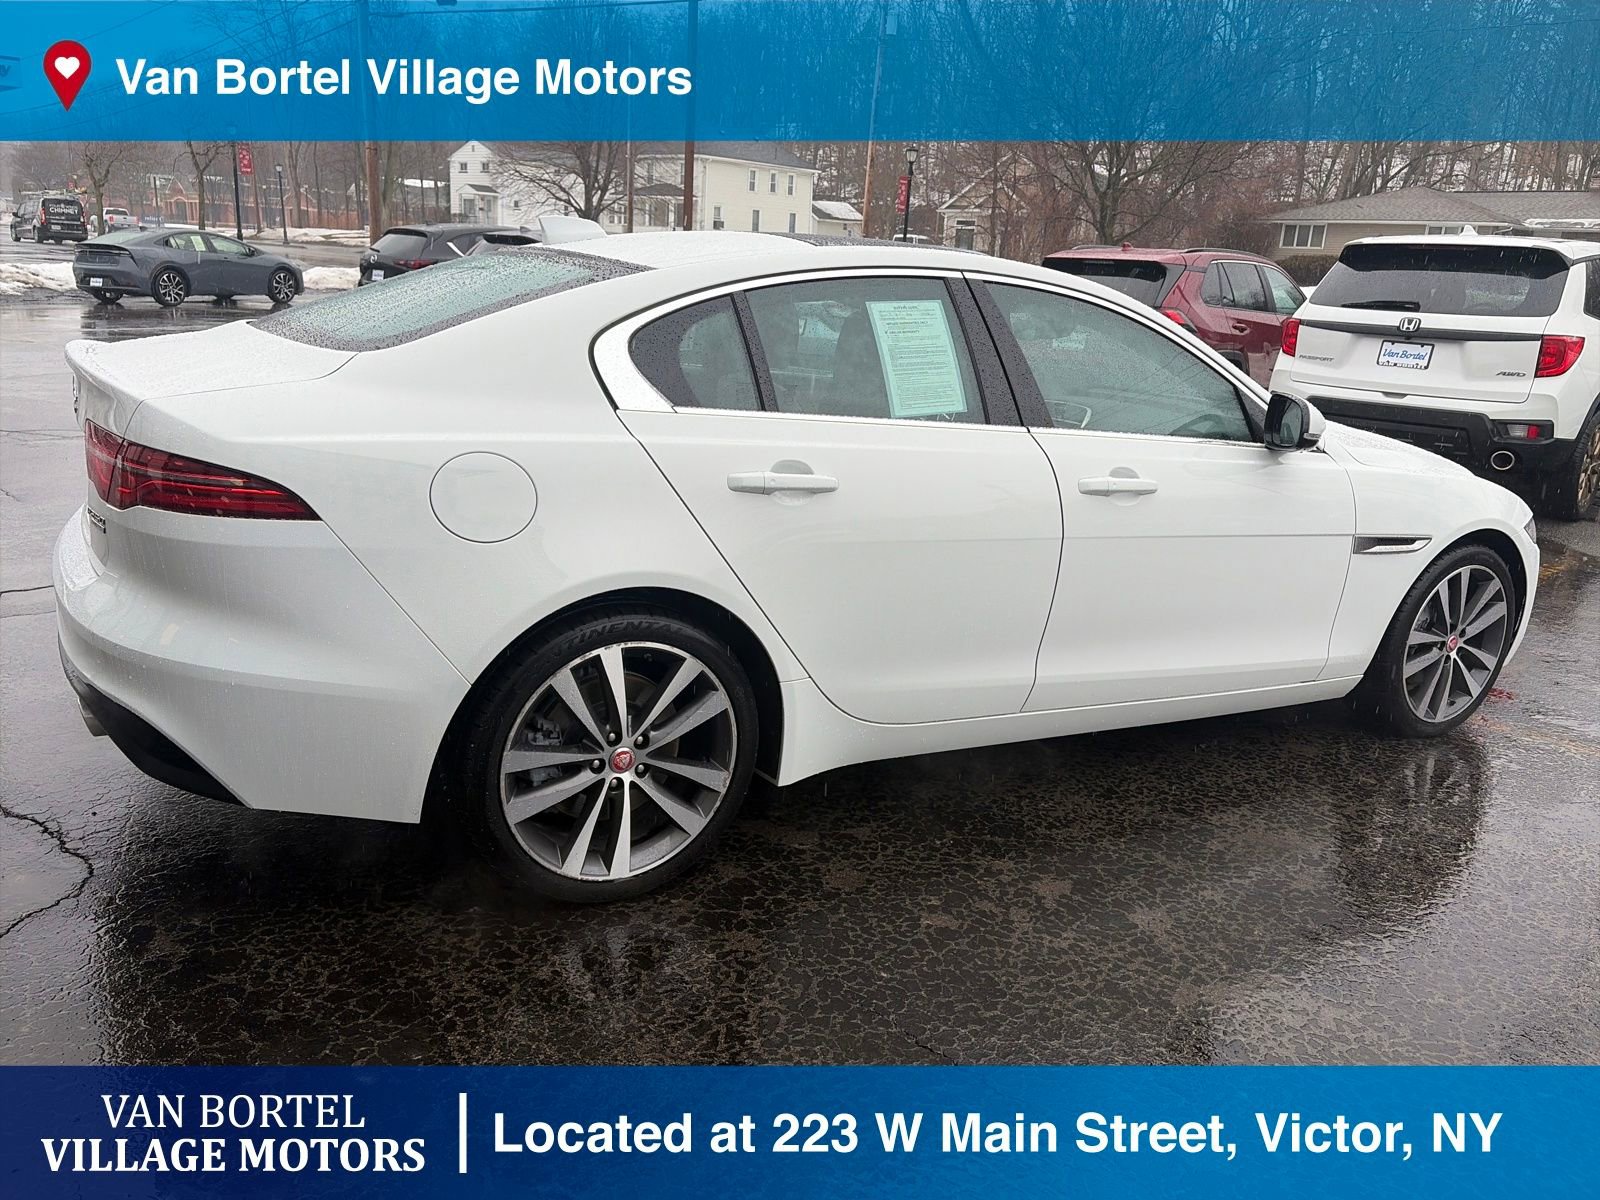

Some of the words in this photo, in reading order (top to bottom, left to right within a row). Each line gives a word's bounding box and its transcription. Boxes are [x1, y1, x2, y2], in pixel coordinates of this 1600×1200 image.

[1298, 353, 1334, 363] PASSPORT
[1382, 348, 1400, 358] Van
[1400, 349, 1428, 361] Bortel
[1495, 370, 1527, 378] AWD
